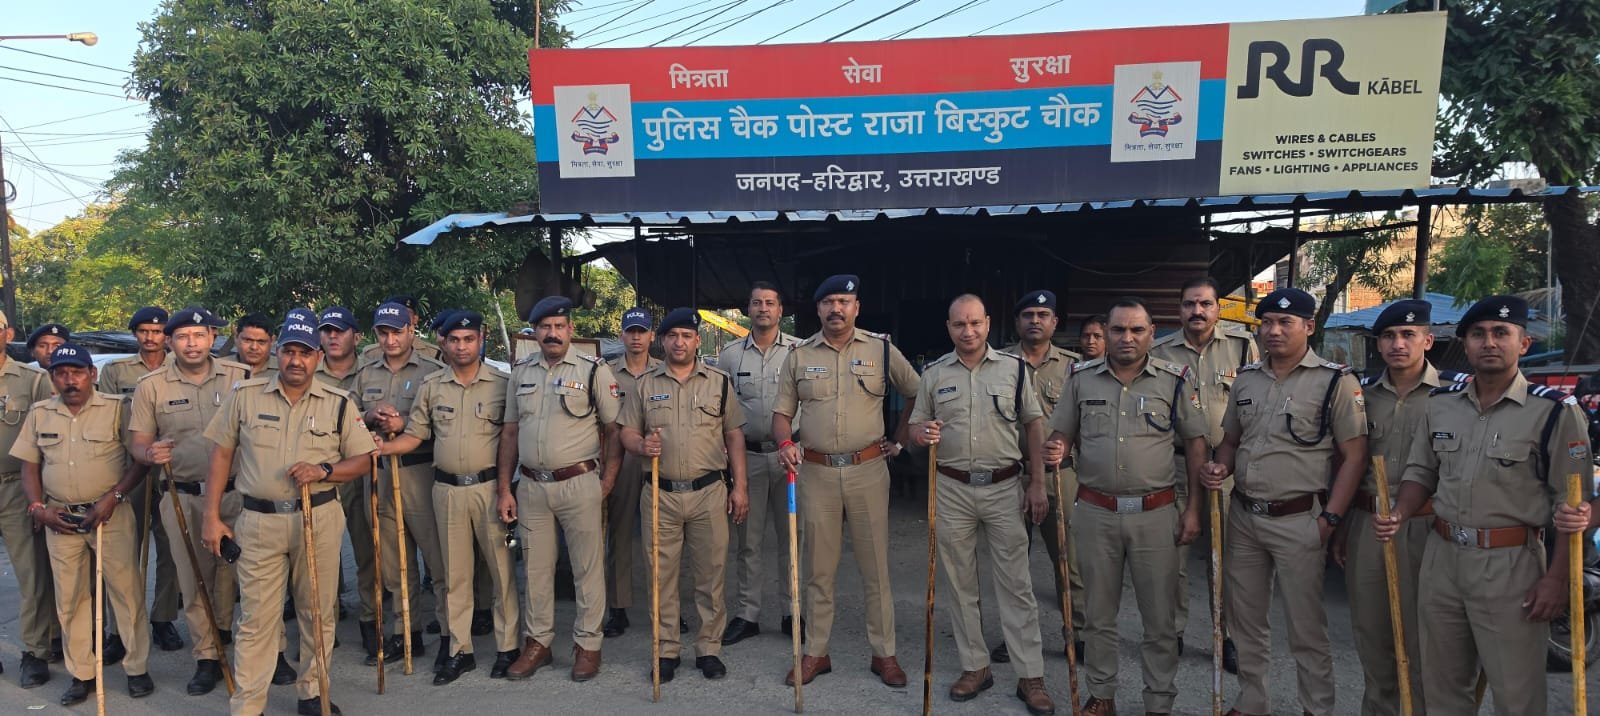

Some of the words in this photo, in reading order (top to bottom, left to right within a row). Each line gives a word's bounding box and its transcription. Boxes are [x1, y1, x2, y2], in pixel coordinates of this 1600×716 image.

[669, 63, 728, 89] मित्रता
[842, 57, 883, 84] सेवा
[1010, 54, 1072, 83] सुरक्षा
[1237, 38, 1360, 99] RR
[1367, 77, 1422, 96] KĀBEL
[642, 107, 720, 152] पुलिस
[731, 104, 778, 139] चैक
[787, 104, 854, 139] पोस्ट
[863, 110, 925, 137] राजा
[935, 99, 1031, 144] बिस्कुट
[1040, 93, 1102, 129] चौक
[1275, 134, 1314, 144] WIRES
[1318, 134, 1326, 143] &
[1330, 133, 1376, 143] CABLES
[1242, 149, 1306, 161] SWITCHES
[1318, 147, 1407, 159] SWITCHGEARS
[1229, 165, 1262, 176] FANS
[1273, 163, 1331, 175] LIGHTING
[1342, 161, 1419, 174] APPLIANCES
[898, 164, 1001, 188] उत्तराखण्ड
[378, 307, 400, 316] POLICE
[626, 311, 645, 319] POLICE
[288, 323, 314, 335] POLICE
[57, 348, 77, 357] PRD
